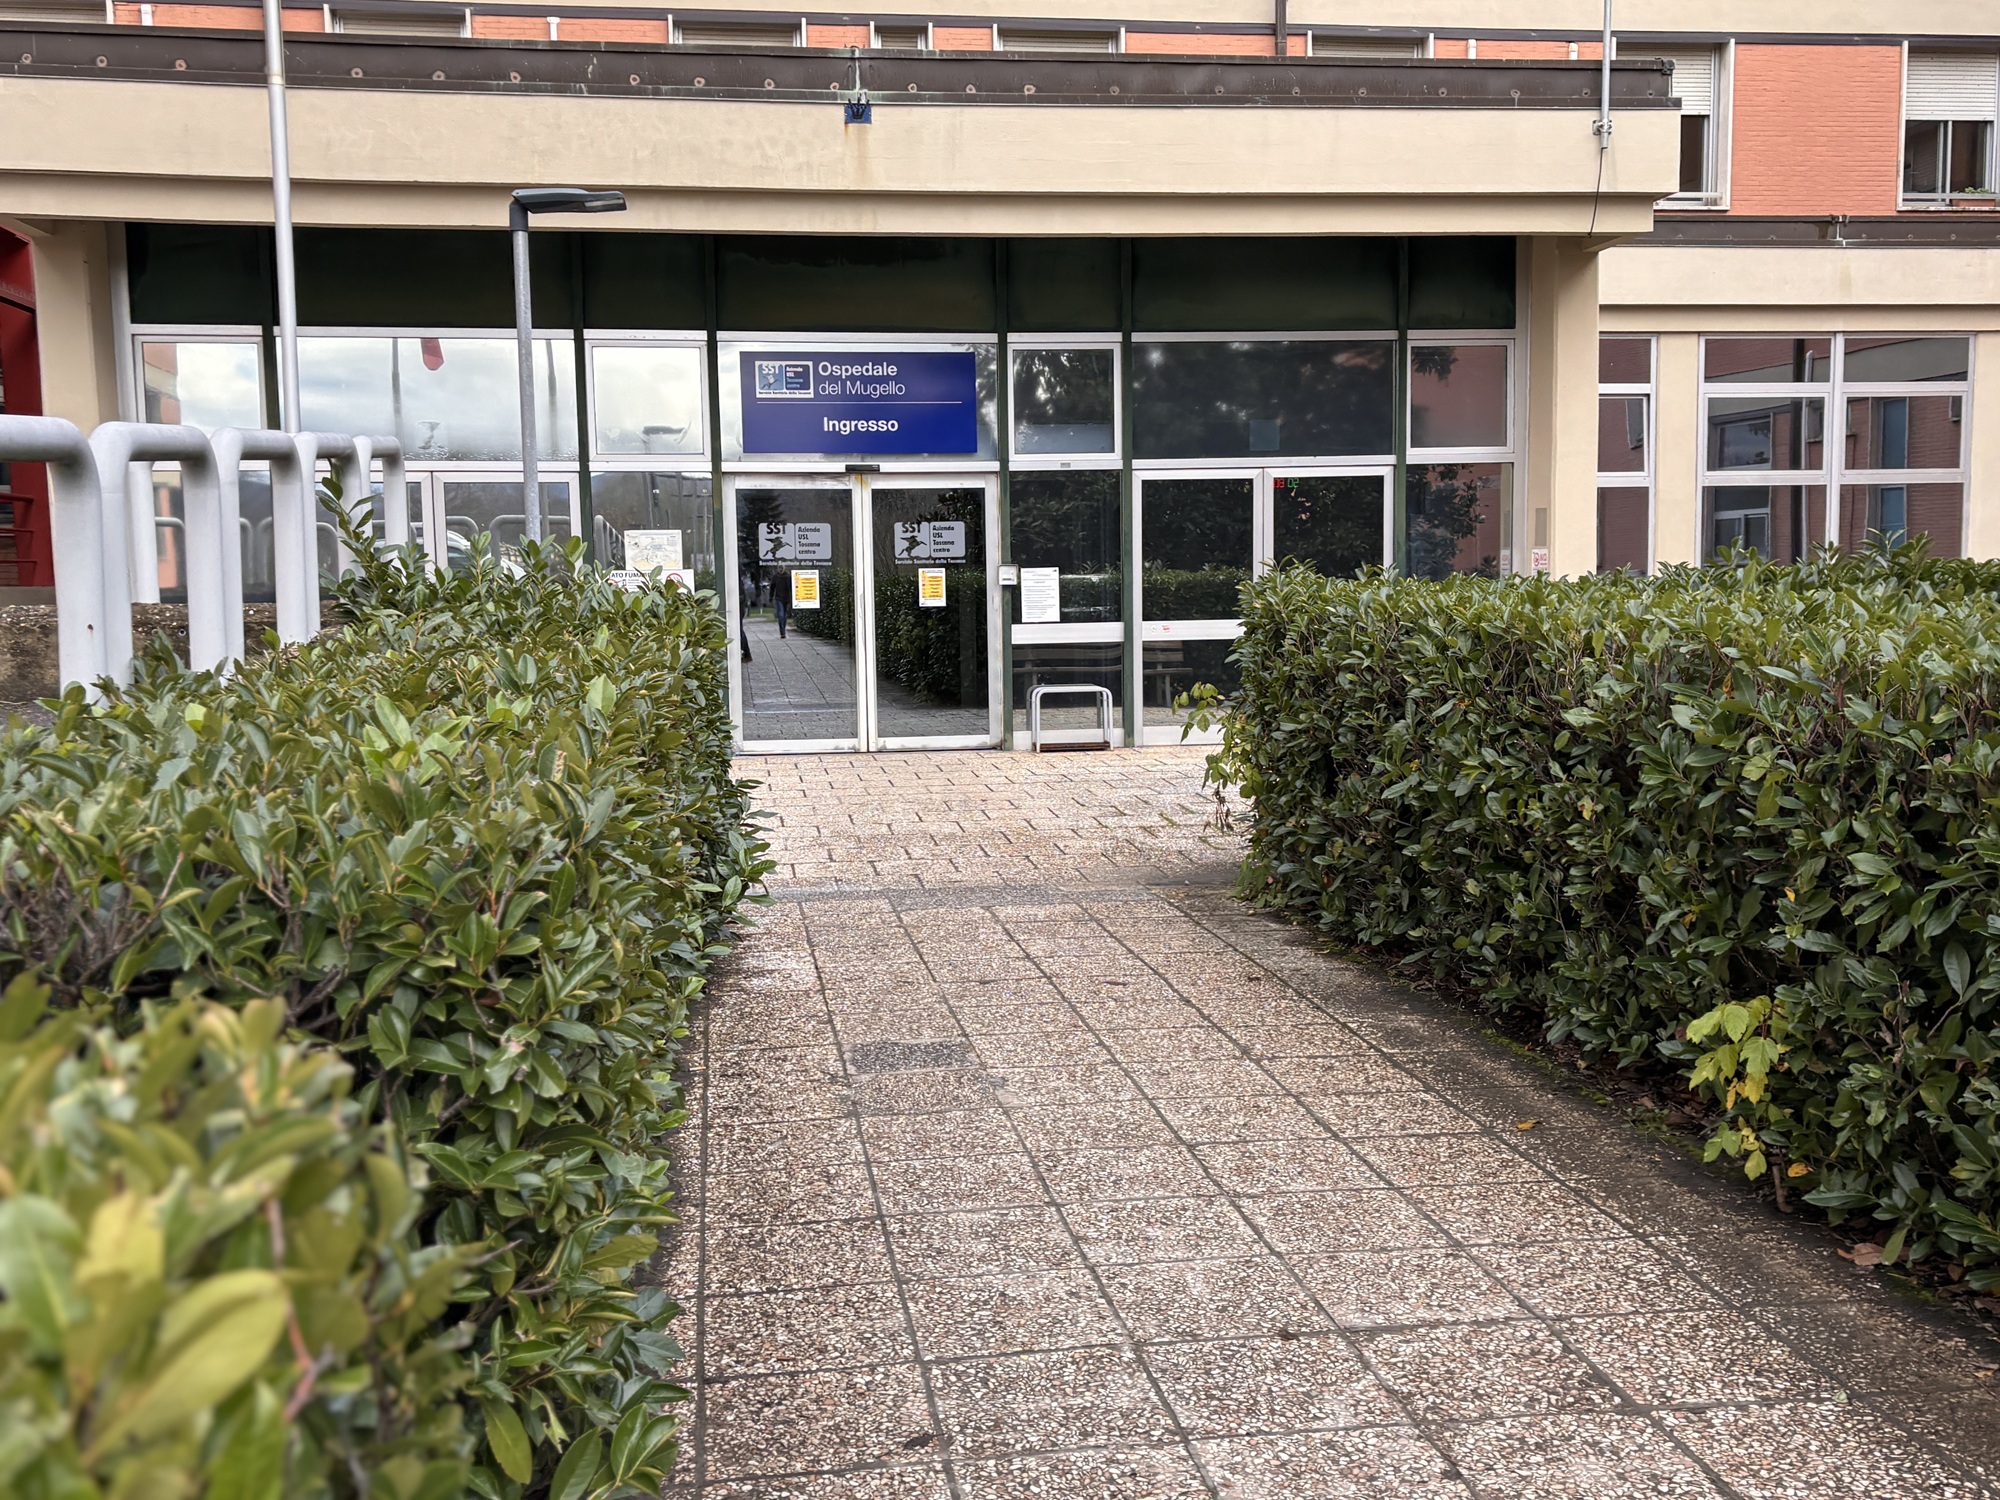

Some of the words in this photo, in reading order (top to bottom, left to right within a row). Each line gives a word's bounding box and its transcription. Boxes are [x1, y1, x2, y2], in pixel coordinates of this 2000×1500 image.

[818, 361, 898, 379] Ospedale
[818, 380, 841, 395] del
[846, 380, 906, 399] Mugello
[823, 416, 899, 435] Ingresso
[766, 521, 787, 535] SST
[901, 521, 922, 534] SST
